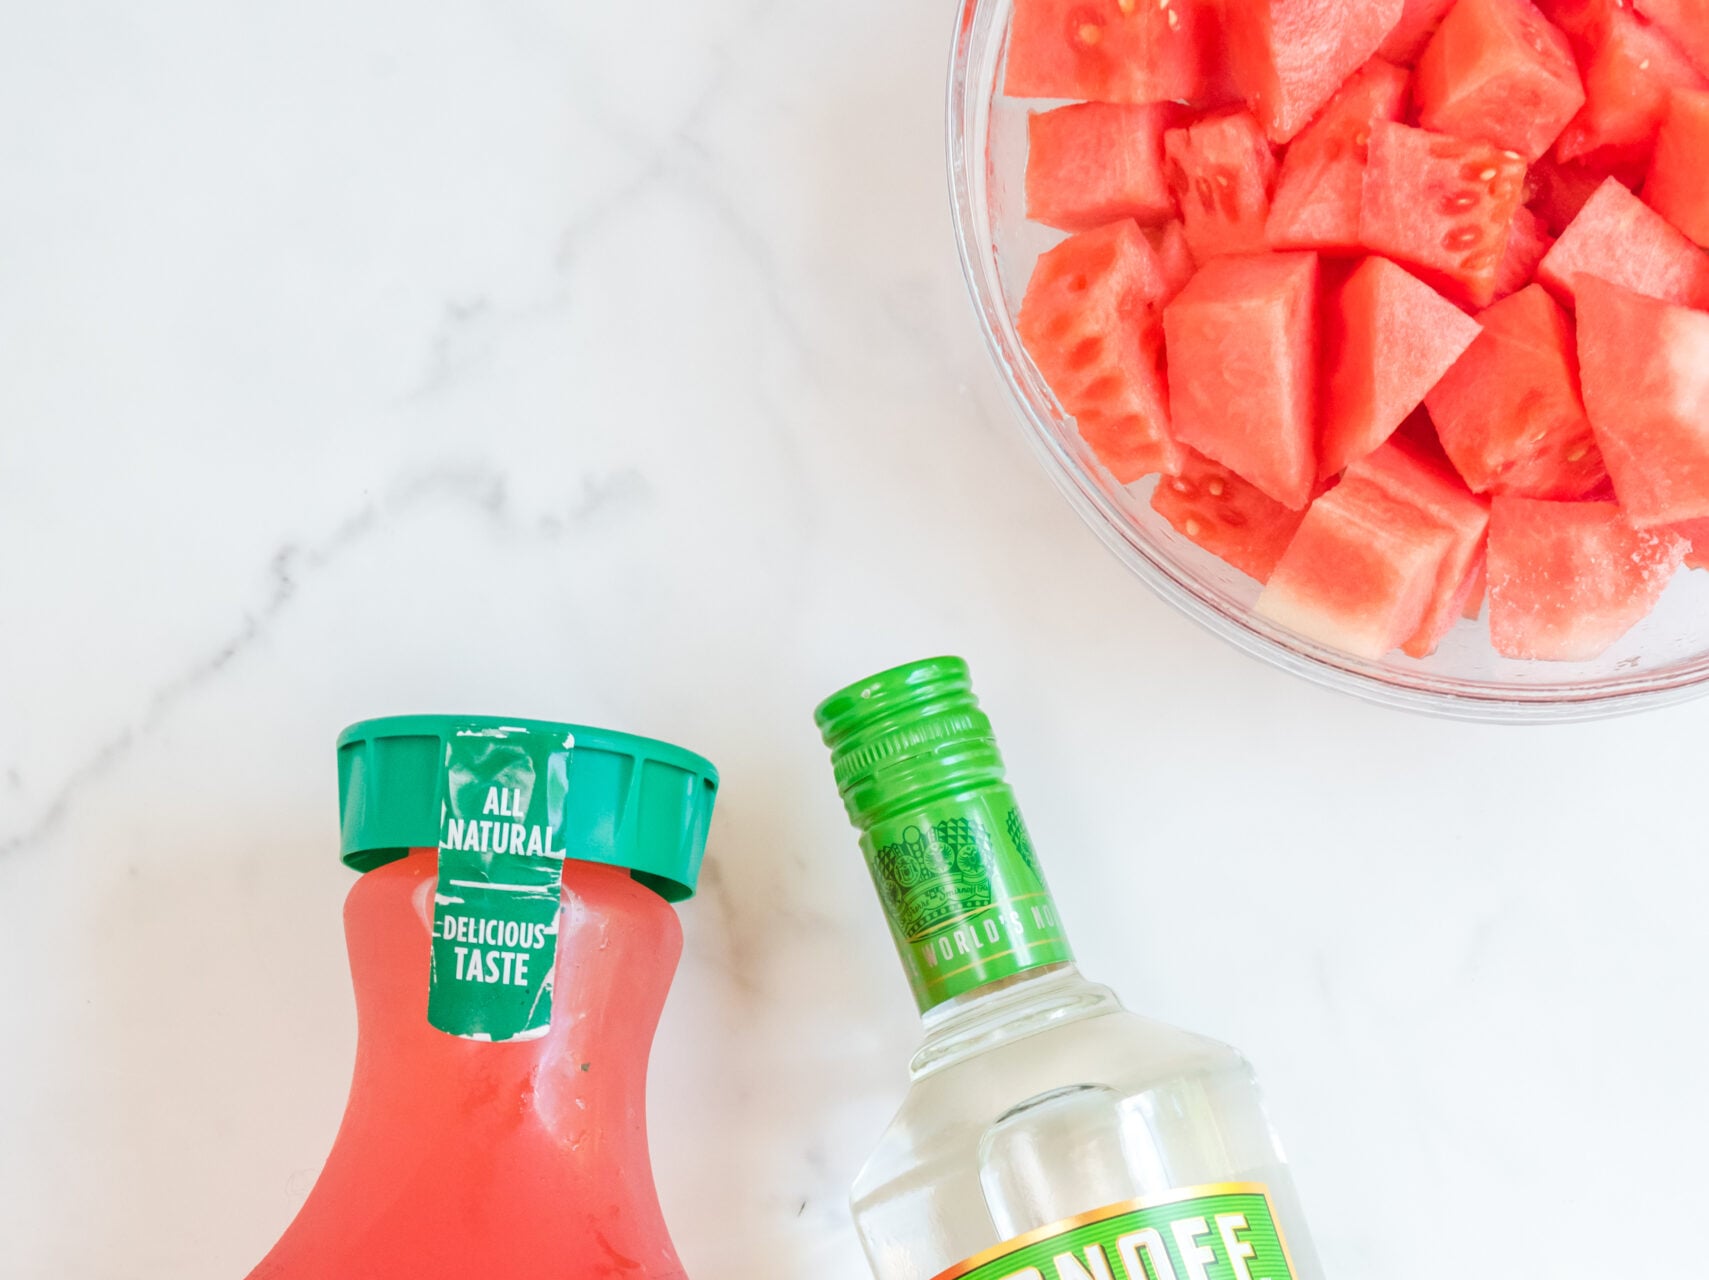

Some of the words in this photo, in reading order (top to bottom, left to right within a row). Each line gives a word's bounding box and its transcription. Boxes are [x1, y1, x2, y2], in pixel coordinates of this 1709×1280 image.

[482, 787, 524, 817] ALL
[447, 819, 556, 858] NATURAL
[443, 915, 546, 949] DELICIOUS
[921, 911, 1024, 968] WORLD'S
[454, 947, 530, 986] TASTE
